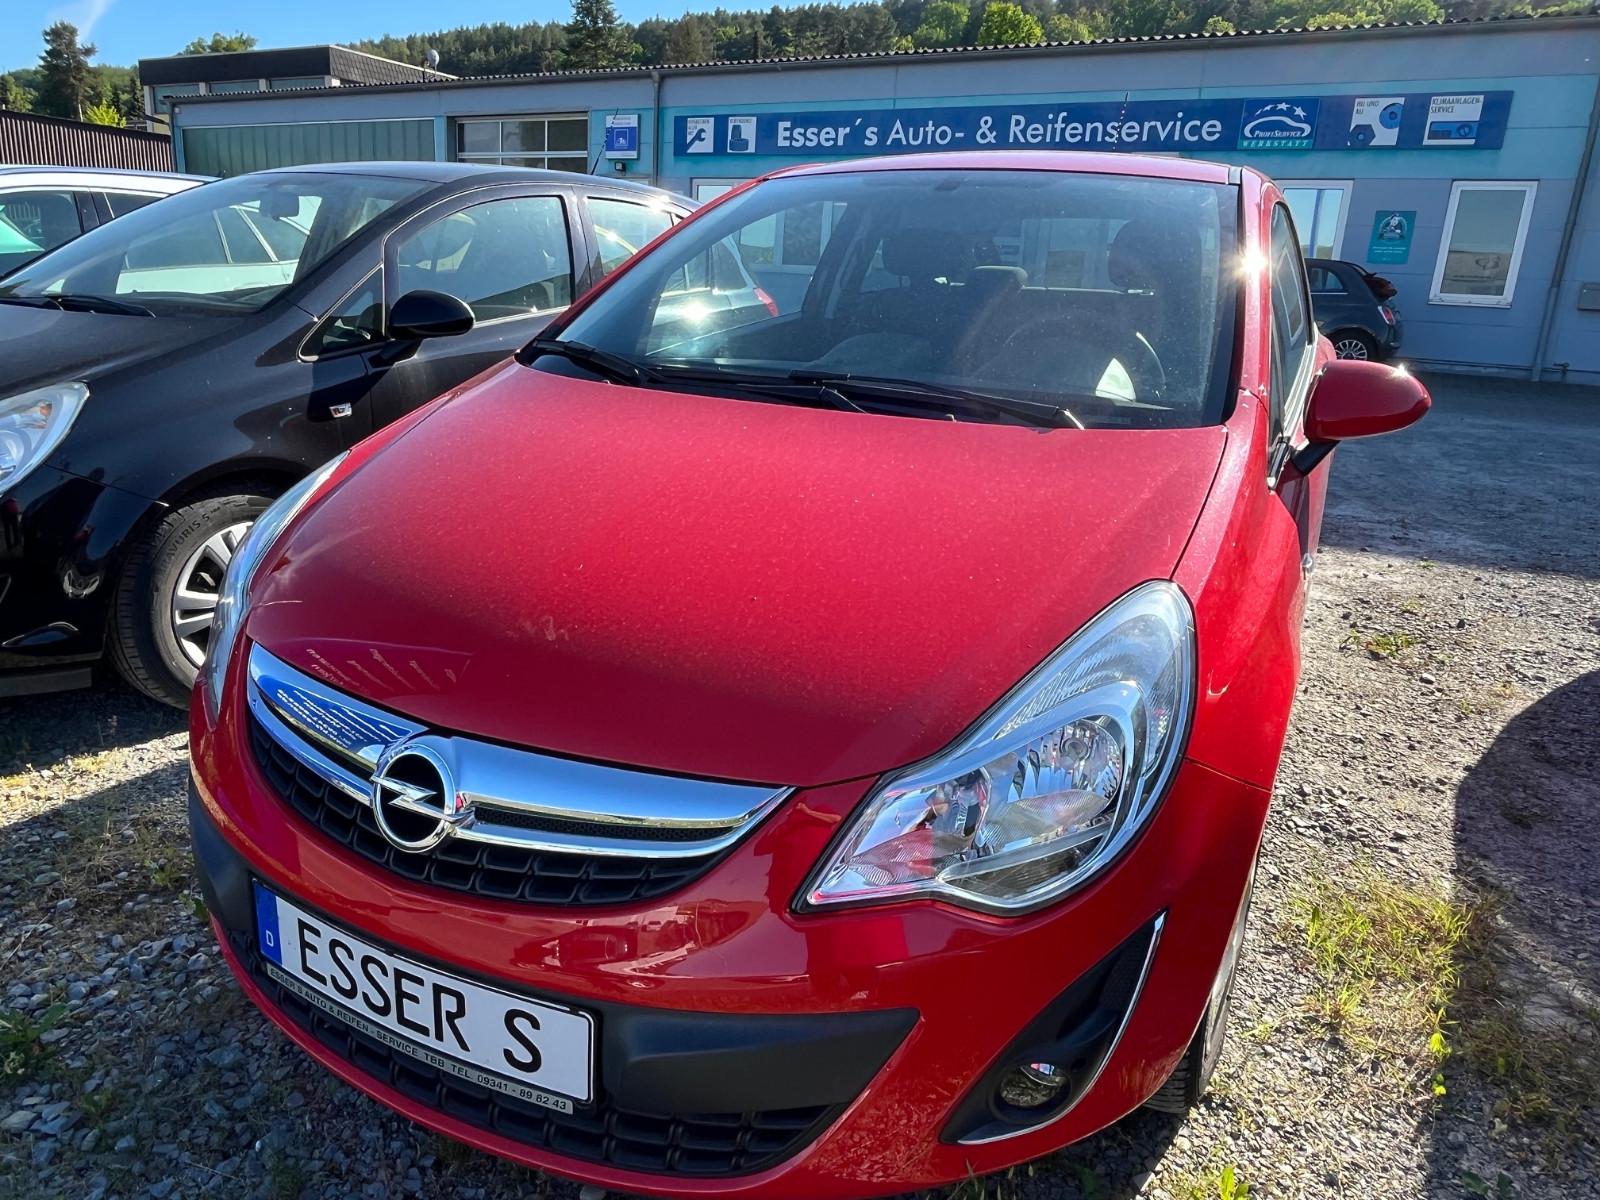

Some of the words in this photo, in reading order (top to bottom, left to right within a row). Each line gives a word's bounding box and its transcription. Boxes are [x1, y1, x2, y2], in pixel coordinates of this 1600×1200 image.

[887, 119, 965, 147] Auto-
[975, 116, 997, 144] &
[1009, 111, 1222, 144] Reifenservice
[265, 929, 274, 947] D
[298, 917, 471, 1052] ESSER
[503, 1008, 542, 1073] S
[304, 989, 327, 1009] AUTO
[328, 1005, 336, 1015] &
[336, 1008, 369, 1033] REIFEN
[376, 1030, 419, 1056] SERVICE
[424, 1053, 445, 1068] TBB
[477, 1073, 509, 1092] 09341
[519, 1088, 533, 1099] 89
[552, 1099, 567, 1111] 43
